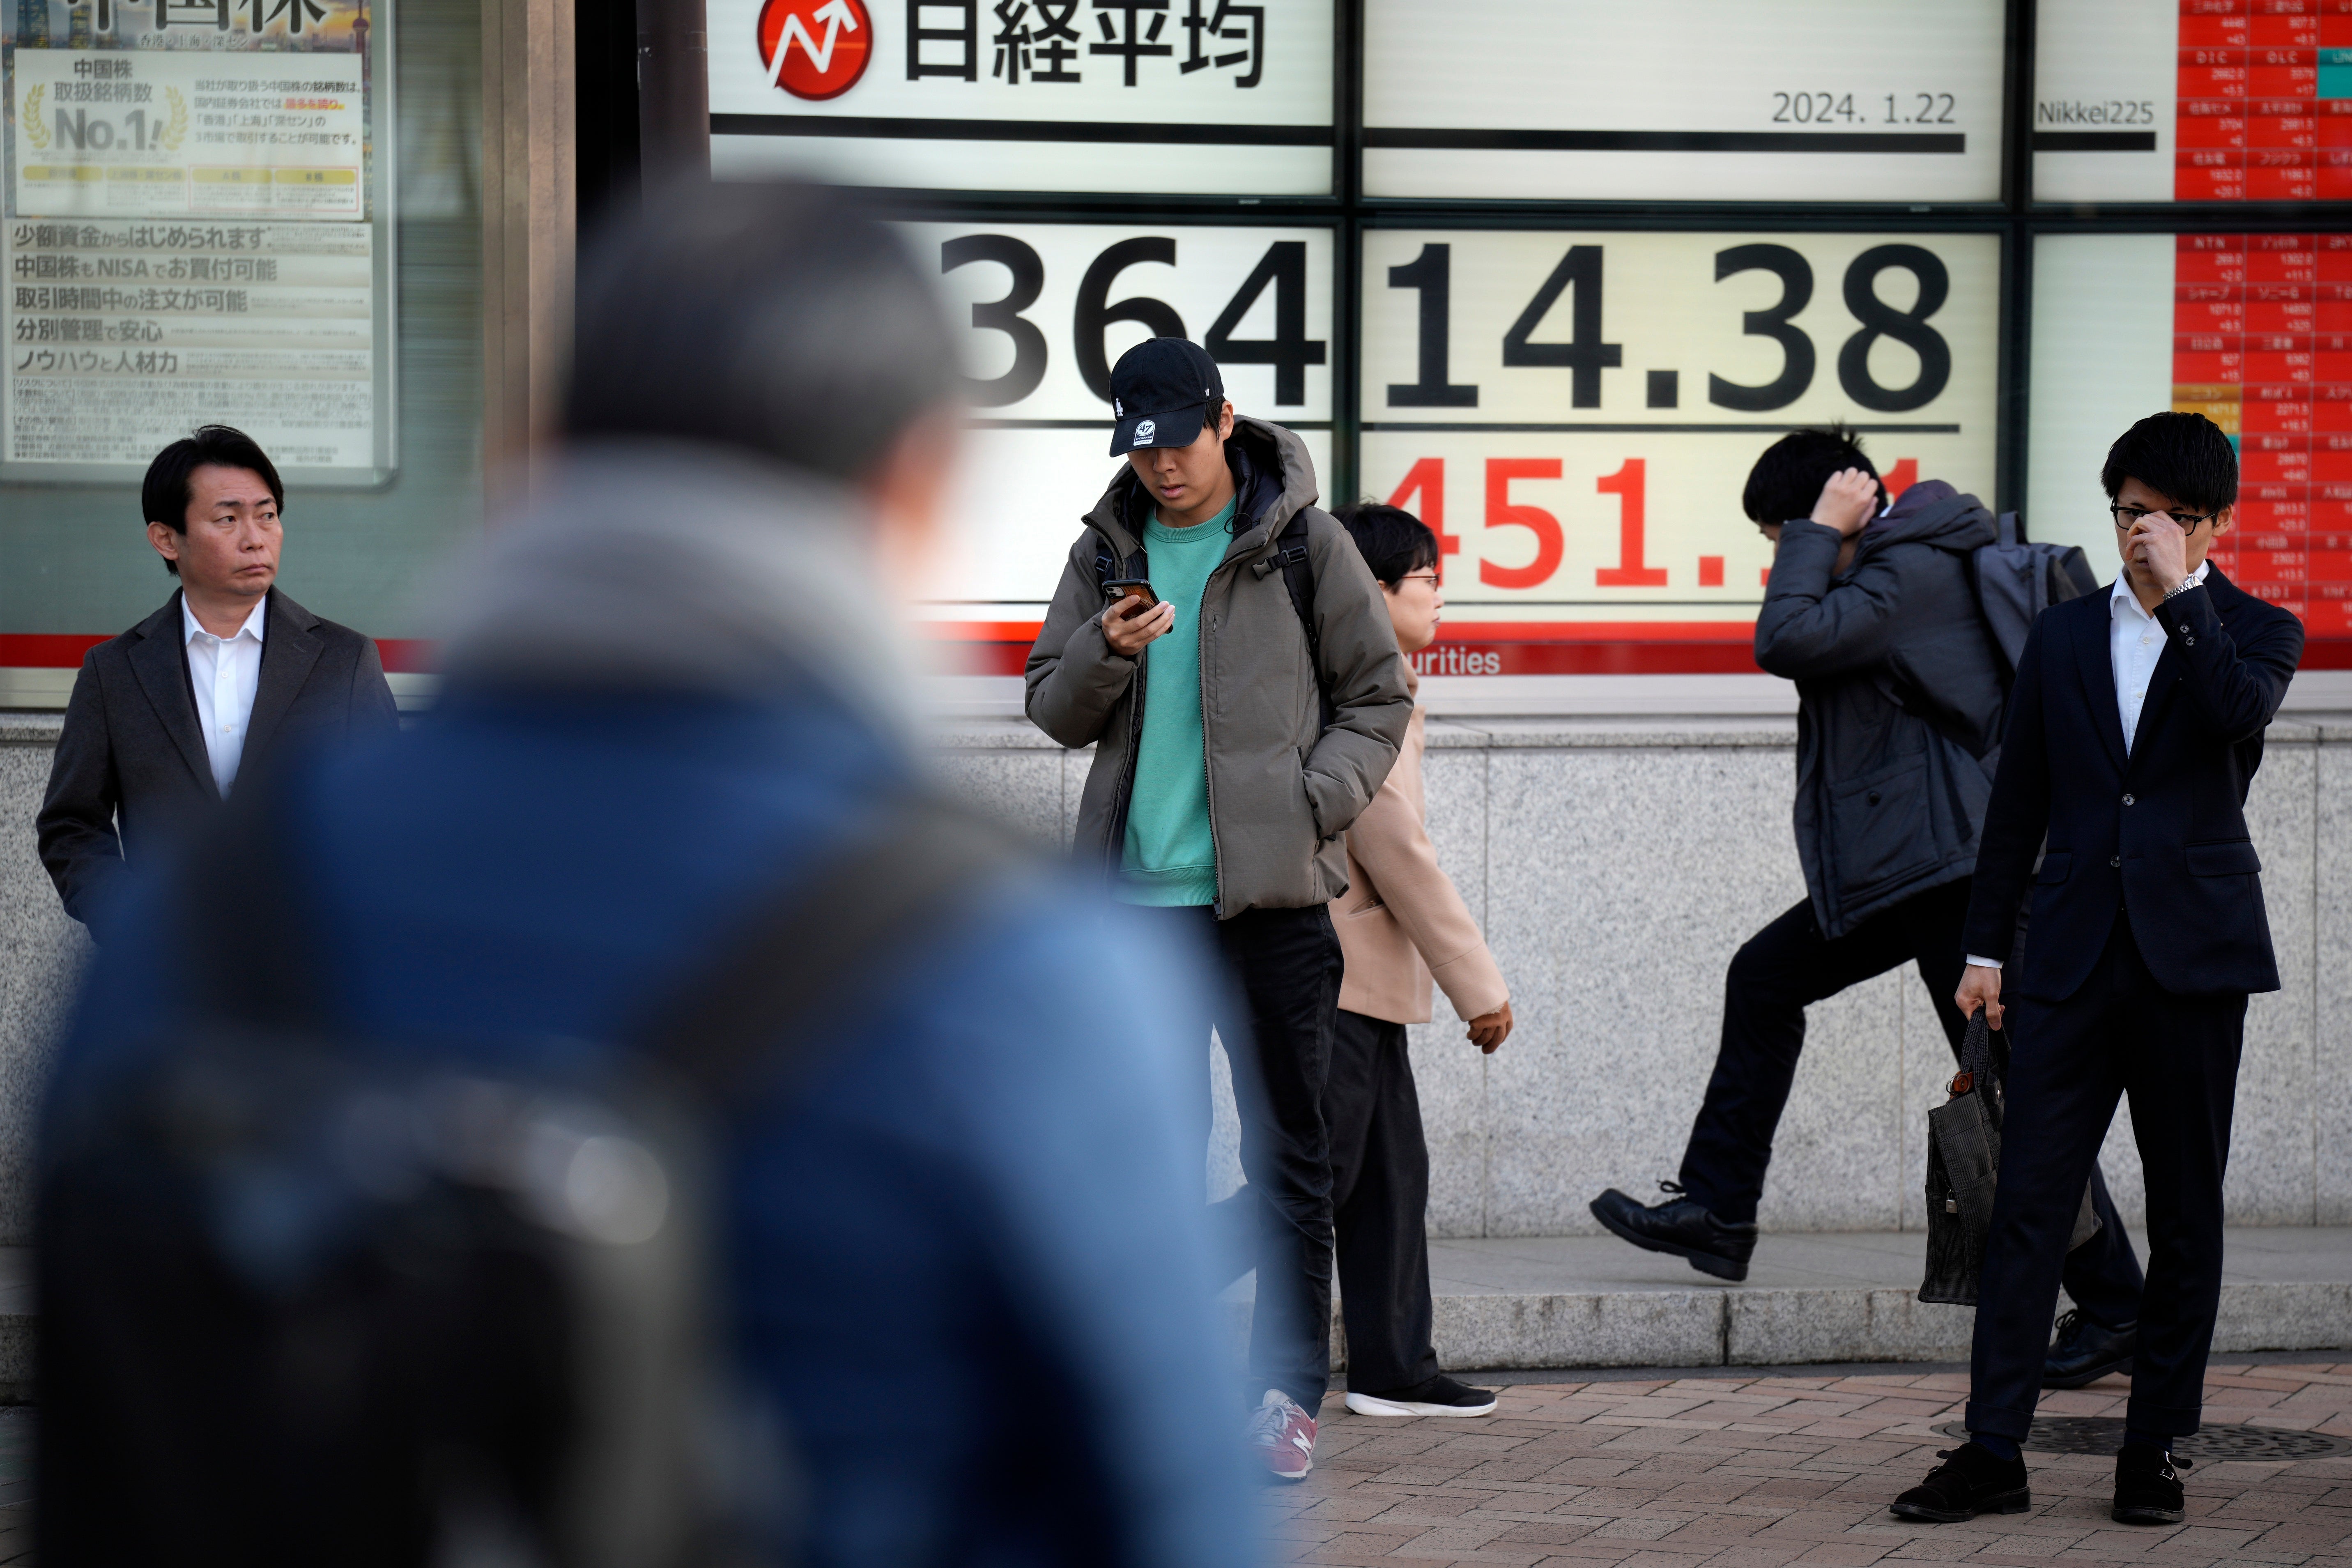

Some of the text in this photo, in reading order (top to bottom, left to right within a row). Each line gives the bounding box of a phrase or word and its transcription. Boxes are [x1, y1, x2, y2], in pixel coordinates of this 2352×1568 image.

[906, 0, 1265, 87] 日経平均
[2196, 51, 2227, 64] DIC
[2267, 51, 2298, 64] OLC
[74, 59, 133, 80] 中国株
[54, 82, 152, 103] 取扱銘柄数
[1772, 92, 1956, 124] 2024. 1.22
[2037, 101, 2154, 125] Nikkei225
[55, 108, 163, 151] No.1!
[14, 225, 266, 248] 少額資金からはじめられます
[15, 287, 248, 313] 取引時間中の注文が可能
[16, 319, 163, 342] 分別管理で安心
[17, 351, 178, 375] ノウハウと人材力
